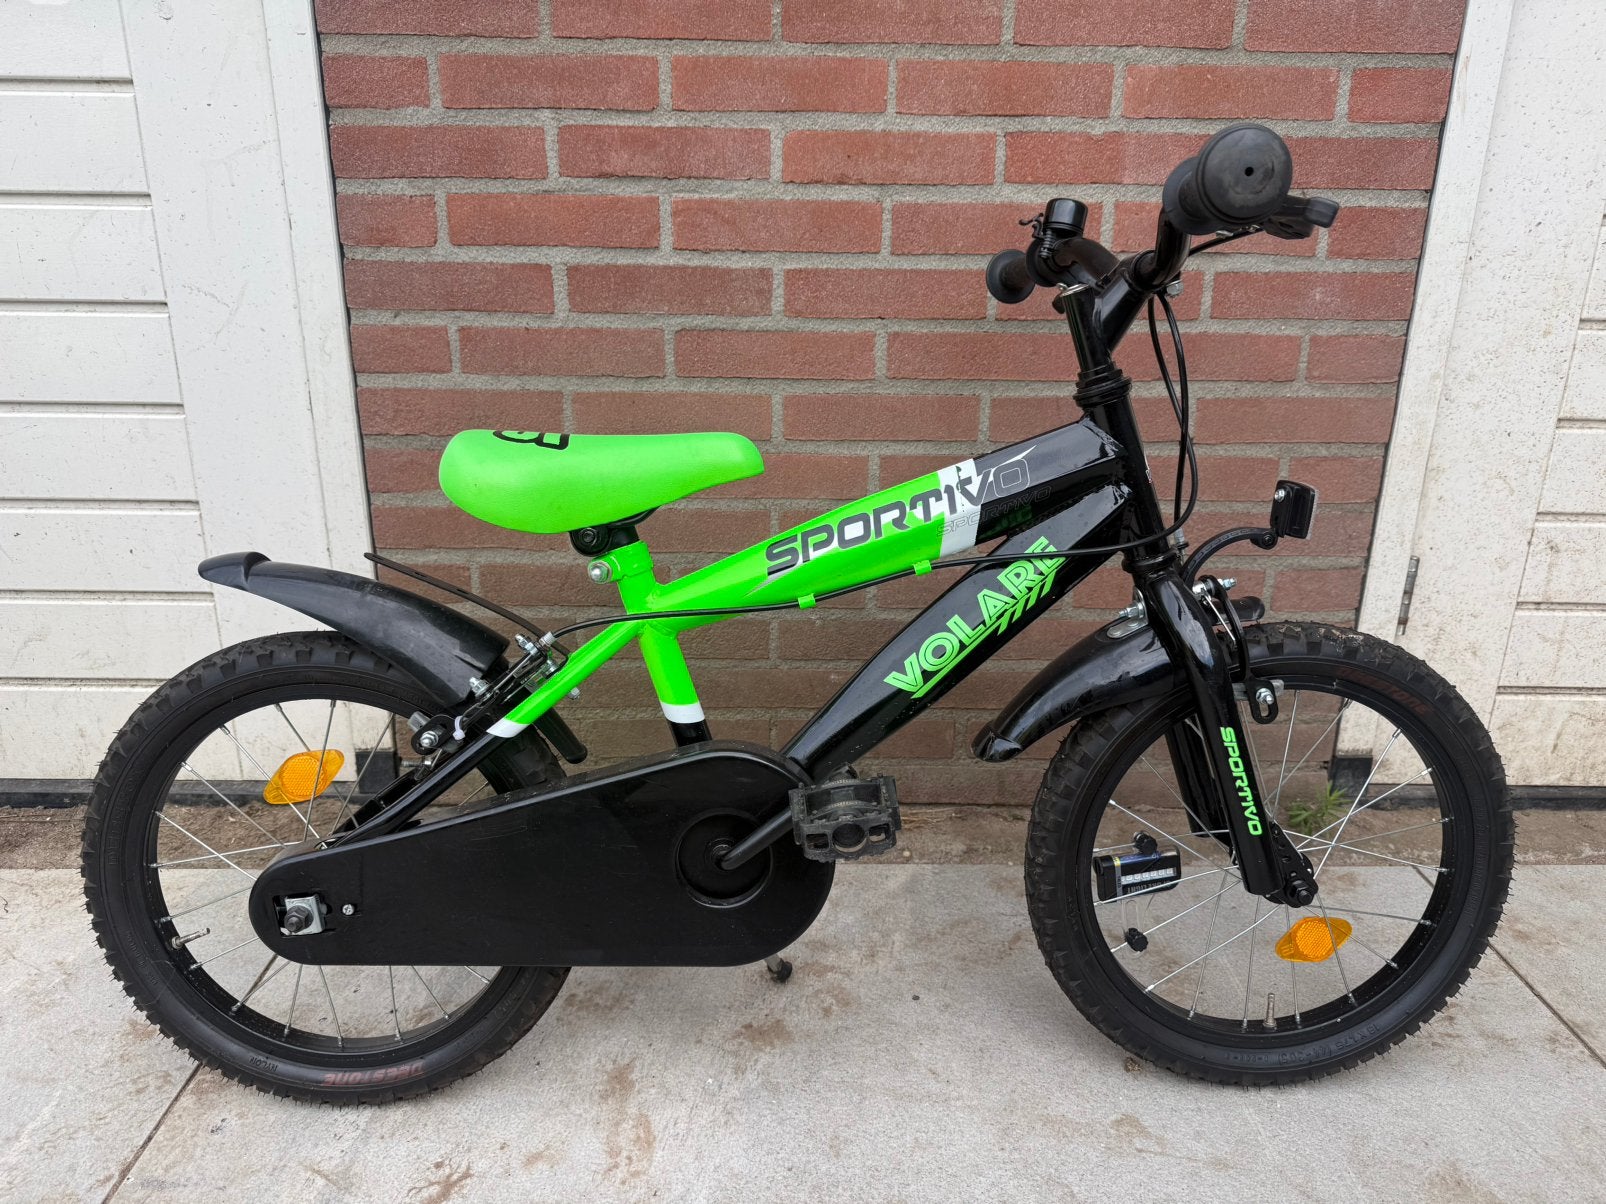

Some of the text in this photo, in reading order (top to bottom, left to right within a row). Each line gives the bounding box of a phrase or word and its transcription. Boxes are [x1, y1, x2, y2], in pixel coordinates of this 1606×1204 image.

[765, 458, 1030, 577] SPORTIVO
[883, 536, 1066, 695] VOLARE
[1220, 727, 1262, 836] SPORTIVO
[249, 1055, 279, 1073] NYLON
